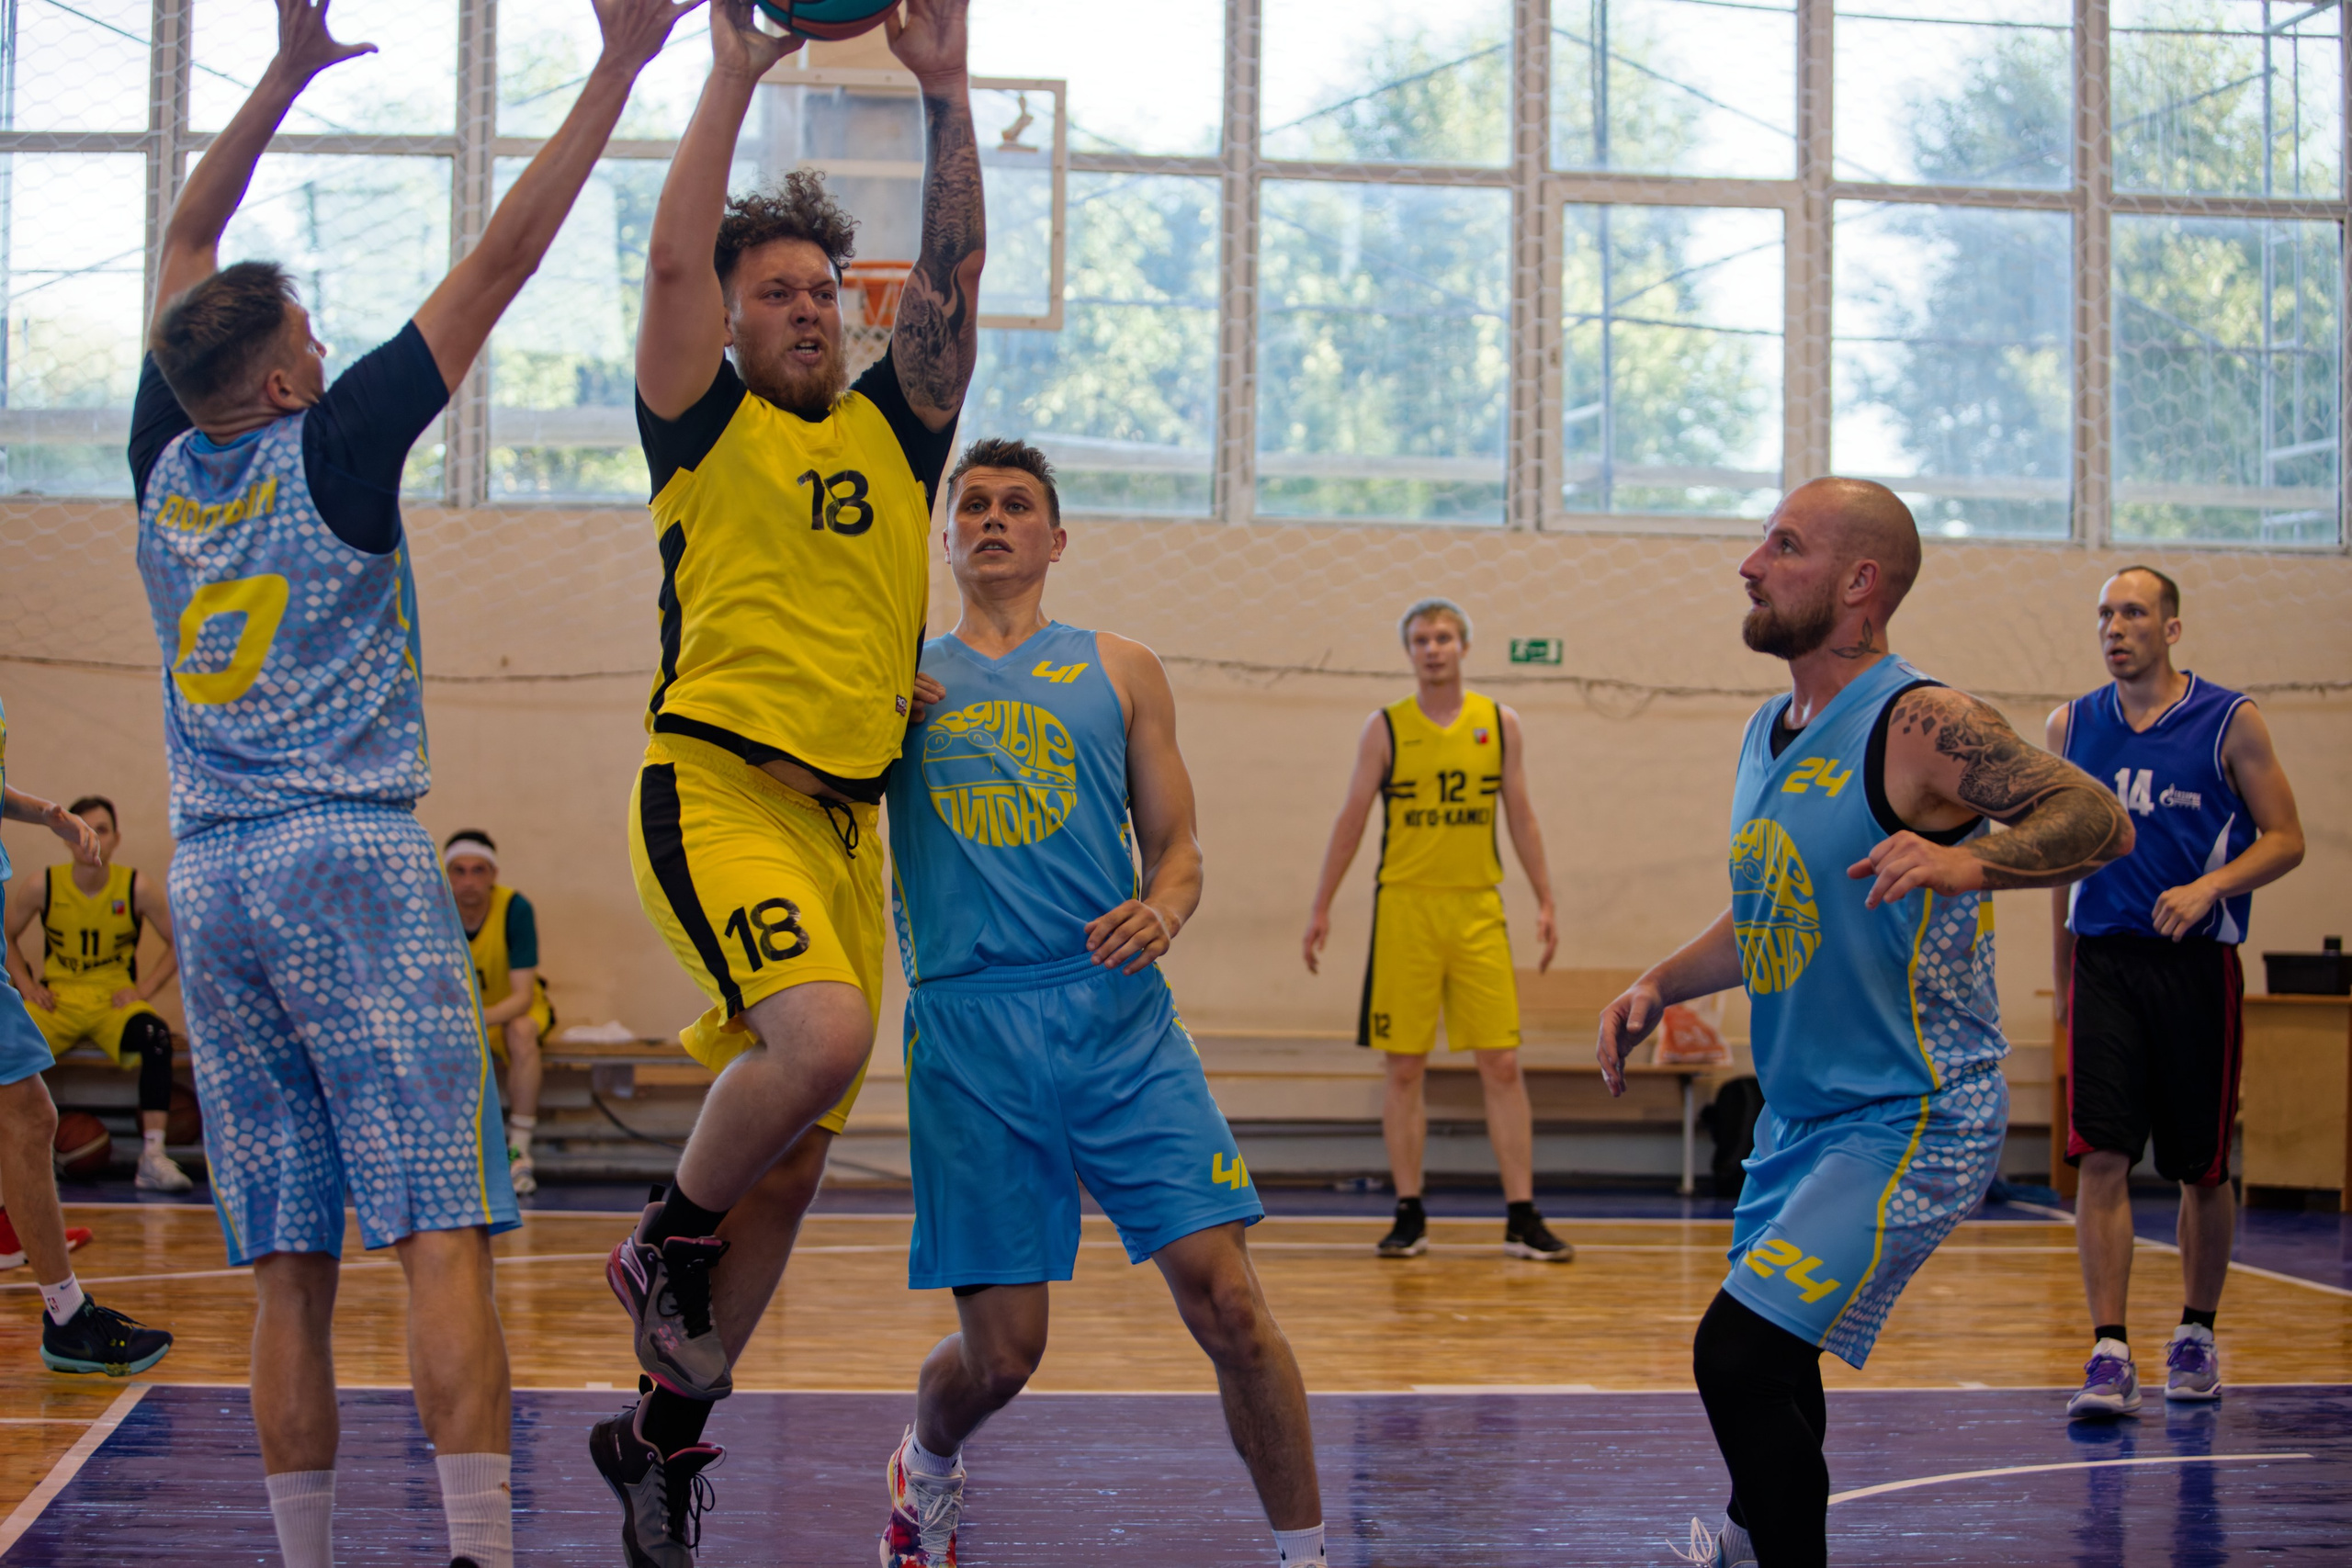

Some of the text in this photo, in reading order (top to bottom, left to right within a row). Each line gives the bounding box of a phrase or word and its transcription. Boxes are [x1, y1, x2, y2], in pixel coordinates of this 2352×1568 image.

[797, 468, 874, 537] 18
[172, 573, 289, 705] 0
[1032, 660, 1089, 683] 41
[1437, 770, 1465, 803] 12
[1781, 757, 1853, 797] 24
[2114, 767, 2154, 817] 14
[930, 785, 1078, 848] ПИТОНЫ
[79, 929, 99, 957] 11
[724, 897, 810, 974] 18
[1374, 1012, 1391, 1040] 12
[1212, 1151, 1250, 1190] 41
[1743, 1239, 1841, 1304] 24
